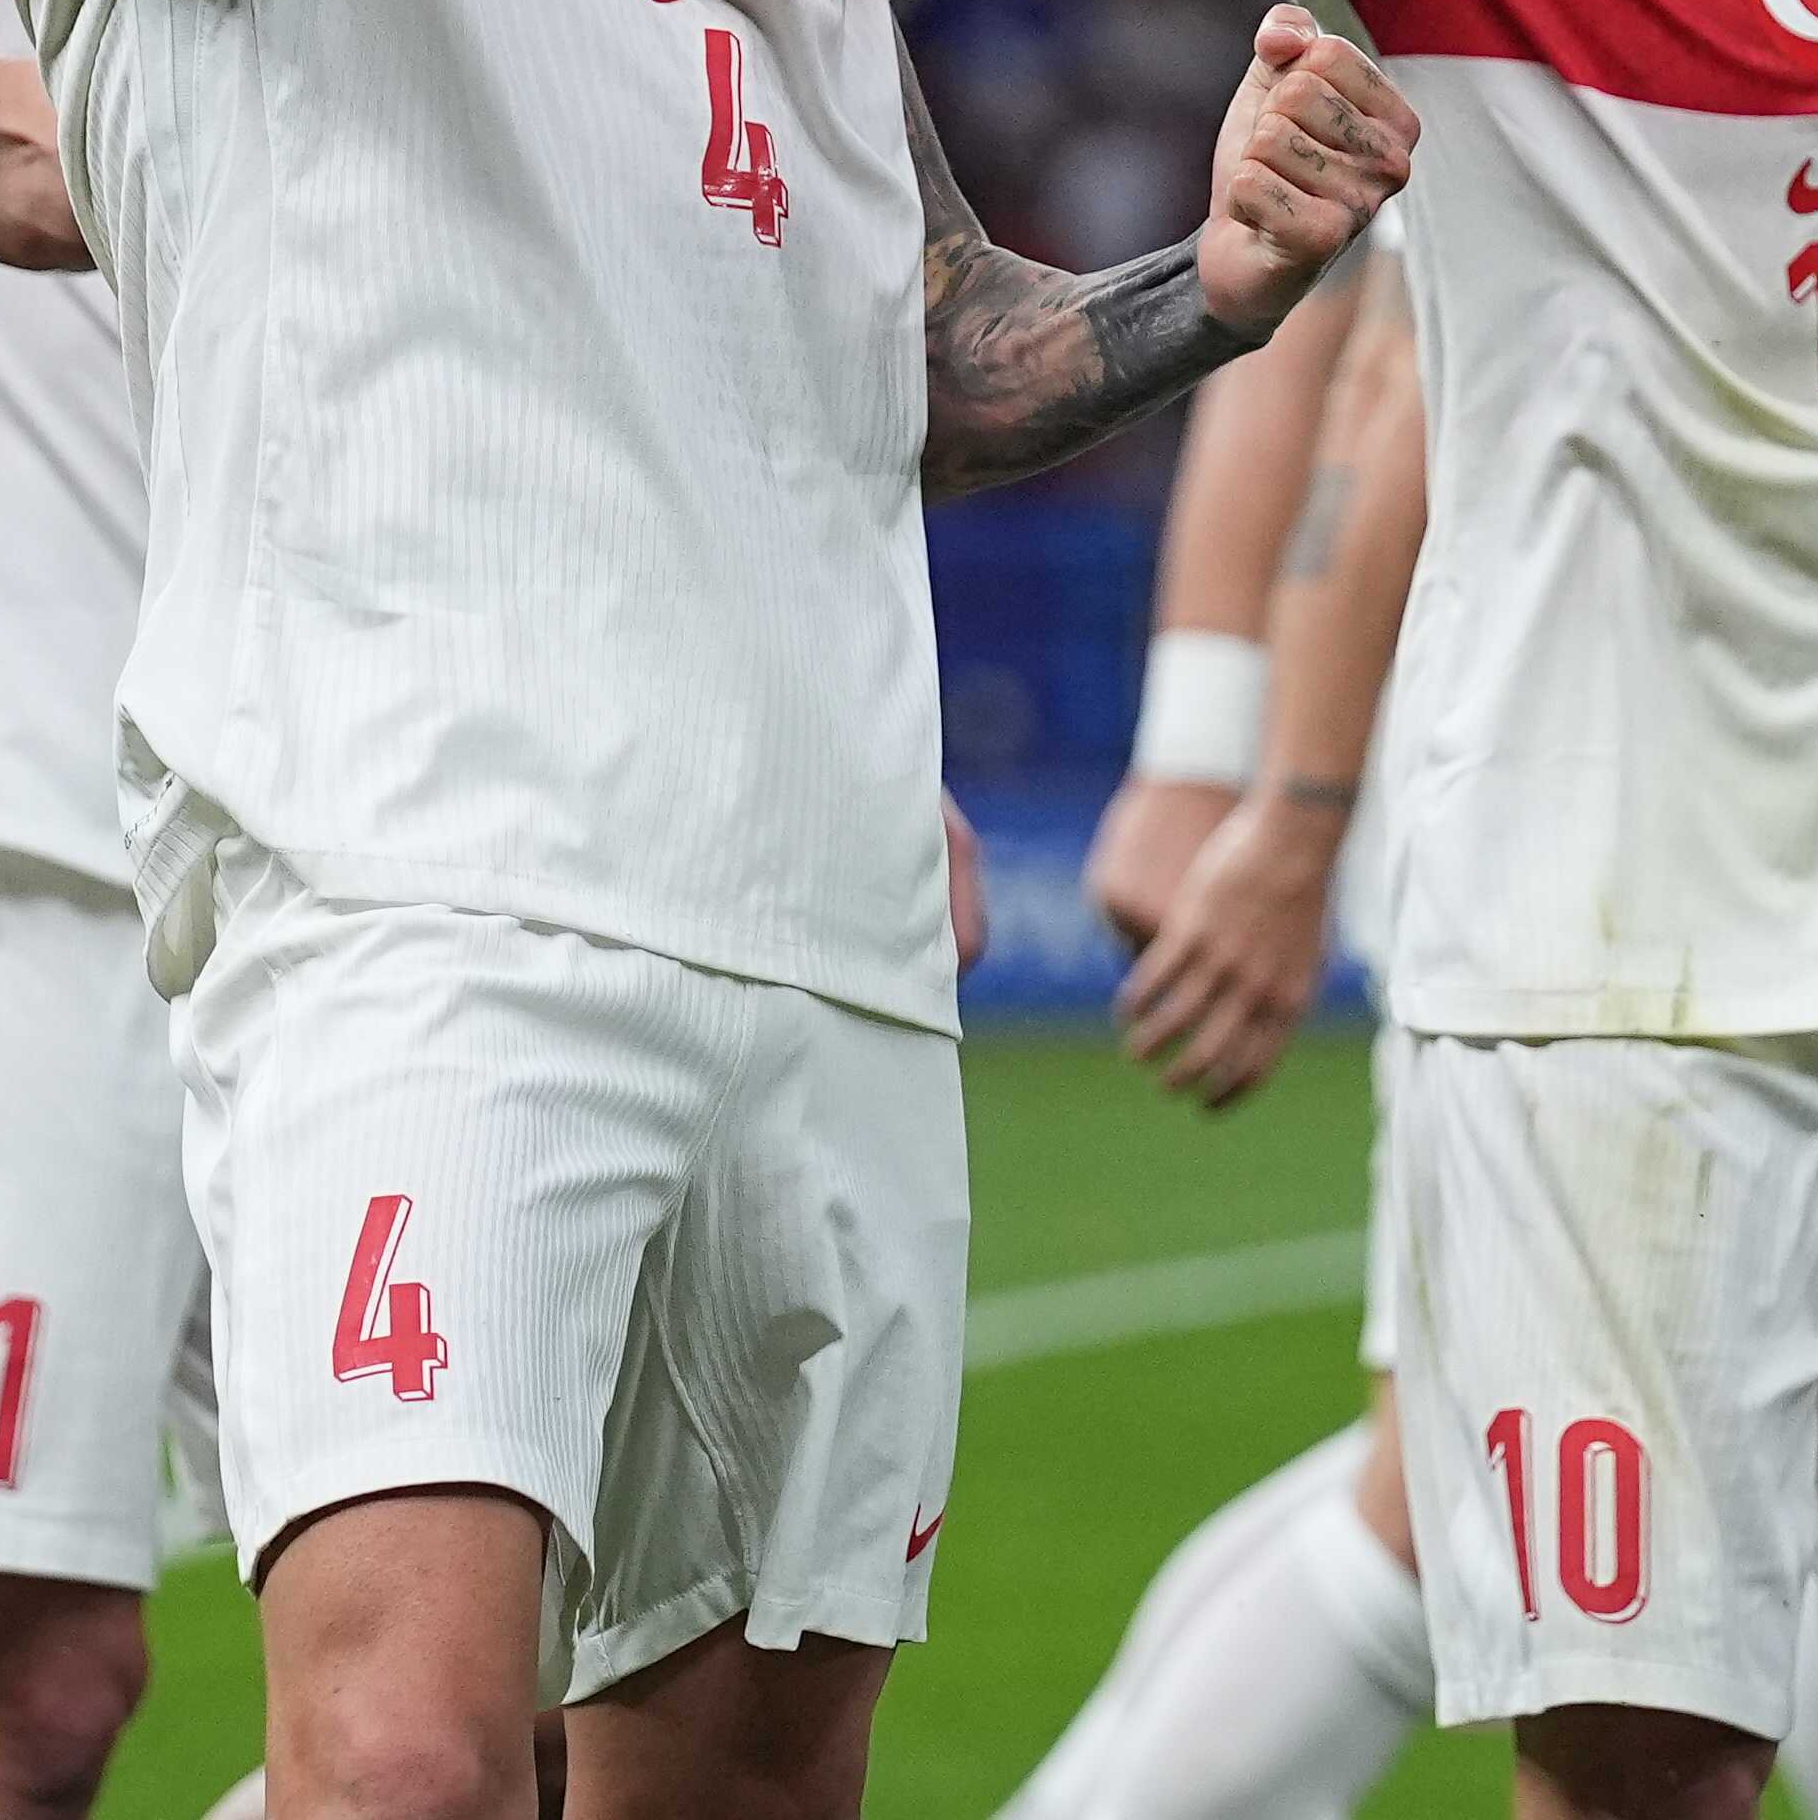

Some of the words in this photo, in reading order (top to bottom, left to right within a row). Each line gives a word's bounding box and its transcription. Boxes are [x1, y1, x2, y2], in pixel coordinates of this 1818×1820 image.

[701, 28, 789, 246] 4
[332, 1194, 449, 1401] 4
[1486, 1407, 1647, 1624] 10
